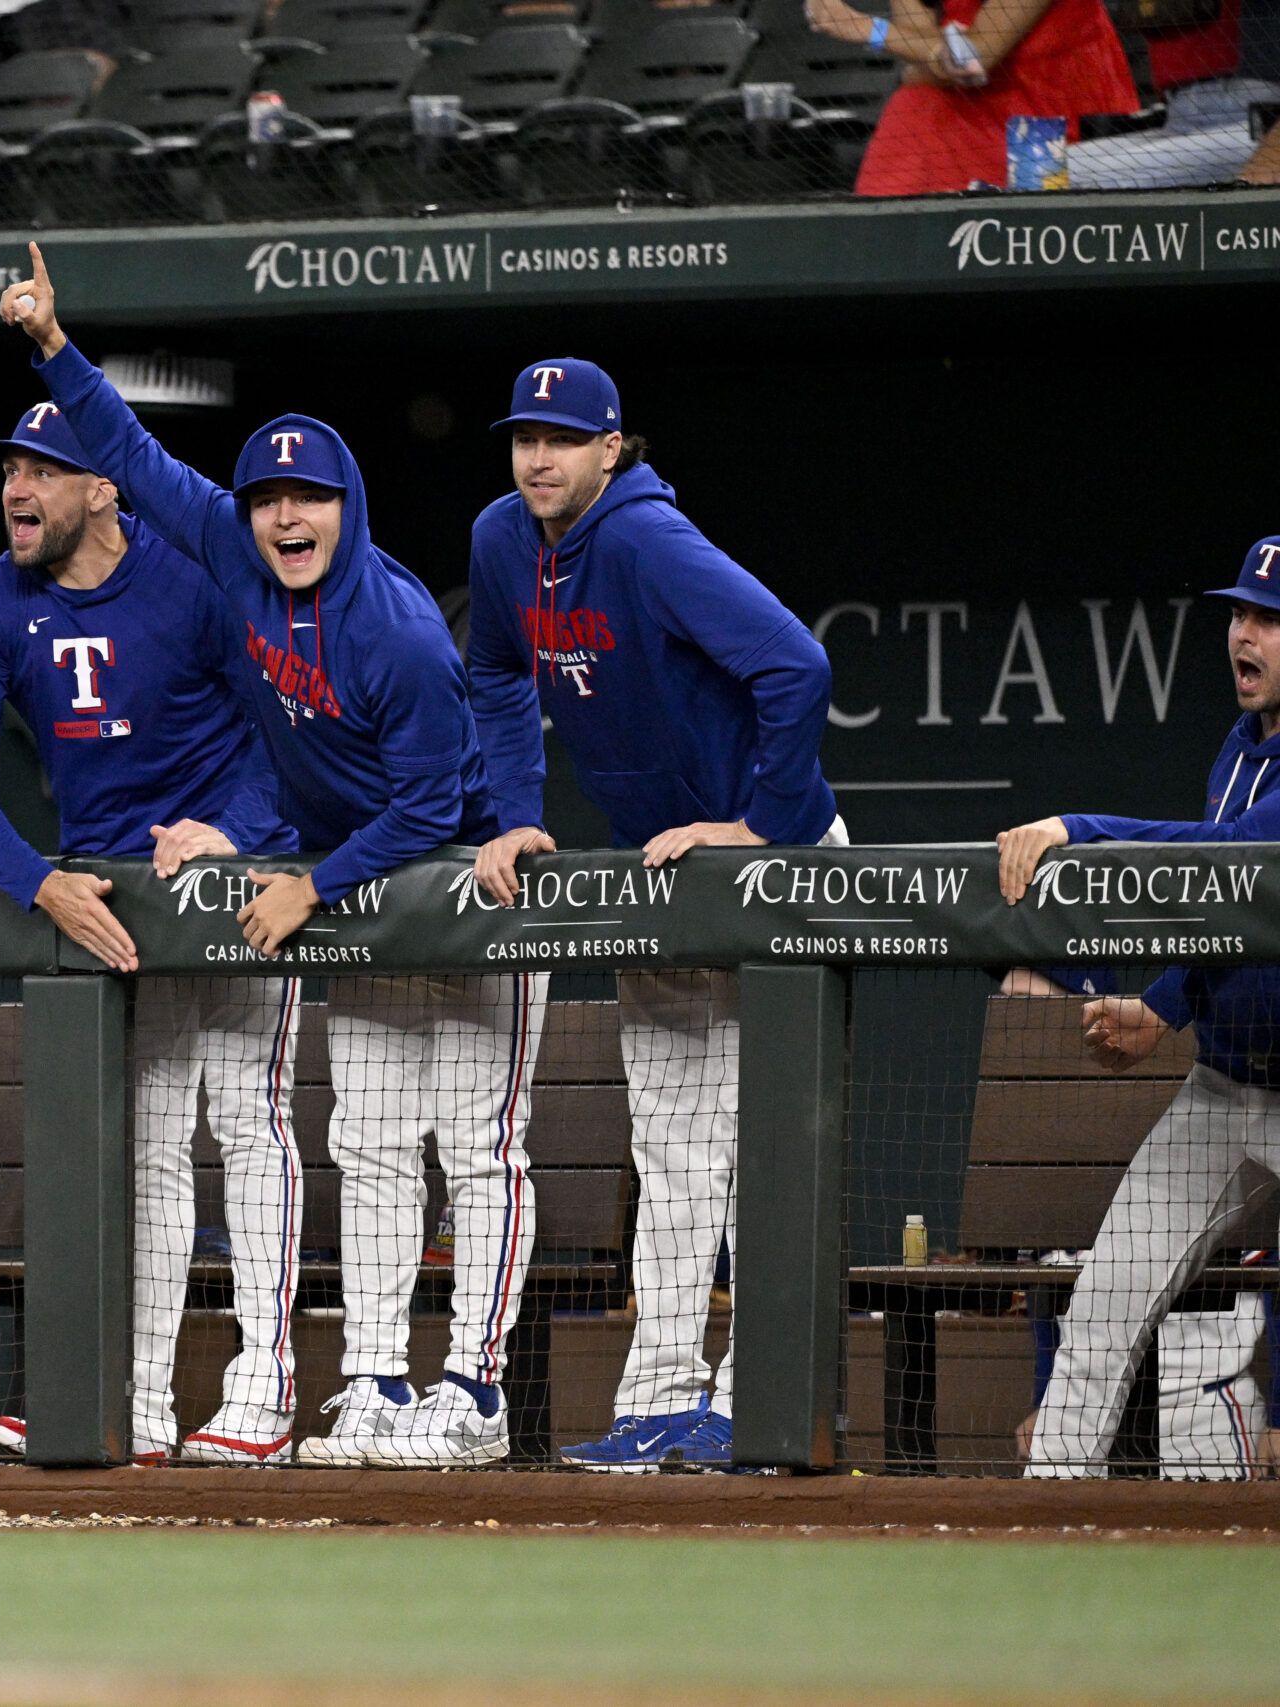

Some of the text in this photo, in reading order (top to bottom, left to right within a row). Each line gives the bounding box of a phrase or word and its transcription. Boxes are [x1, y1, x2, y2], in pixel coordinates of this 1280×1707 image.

[500, 242, 728, 272] CASINOS & RESORTS
[972, 218, 1189, 266] CHOCTAW
[270, 241, 477, 289] CHOCTAW
[533, 367, 565, 400] T
[27, 402, 60, 432] T
[271, 432, 303, 465] T
[53, 637, 115, 714] T
[814, 598, 1194, 729] CTAW
[561, 664, 595, 698] T
[757, 859, 969, 905] CHOCTAW
[1052, 859, 1263, 905] CHOCTAW
[284, 946, 294, 962] &
[299, 946, 372, 963] RESORTS
[486, 938, 659, 960] CASINOS & RESORTS
[771, 937, 948, 955] CASINOS & RESORTS
[1066, 936, 1244, 955] CASINOS & RESORTS
